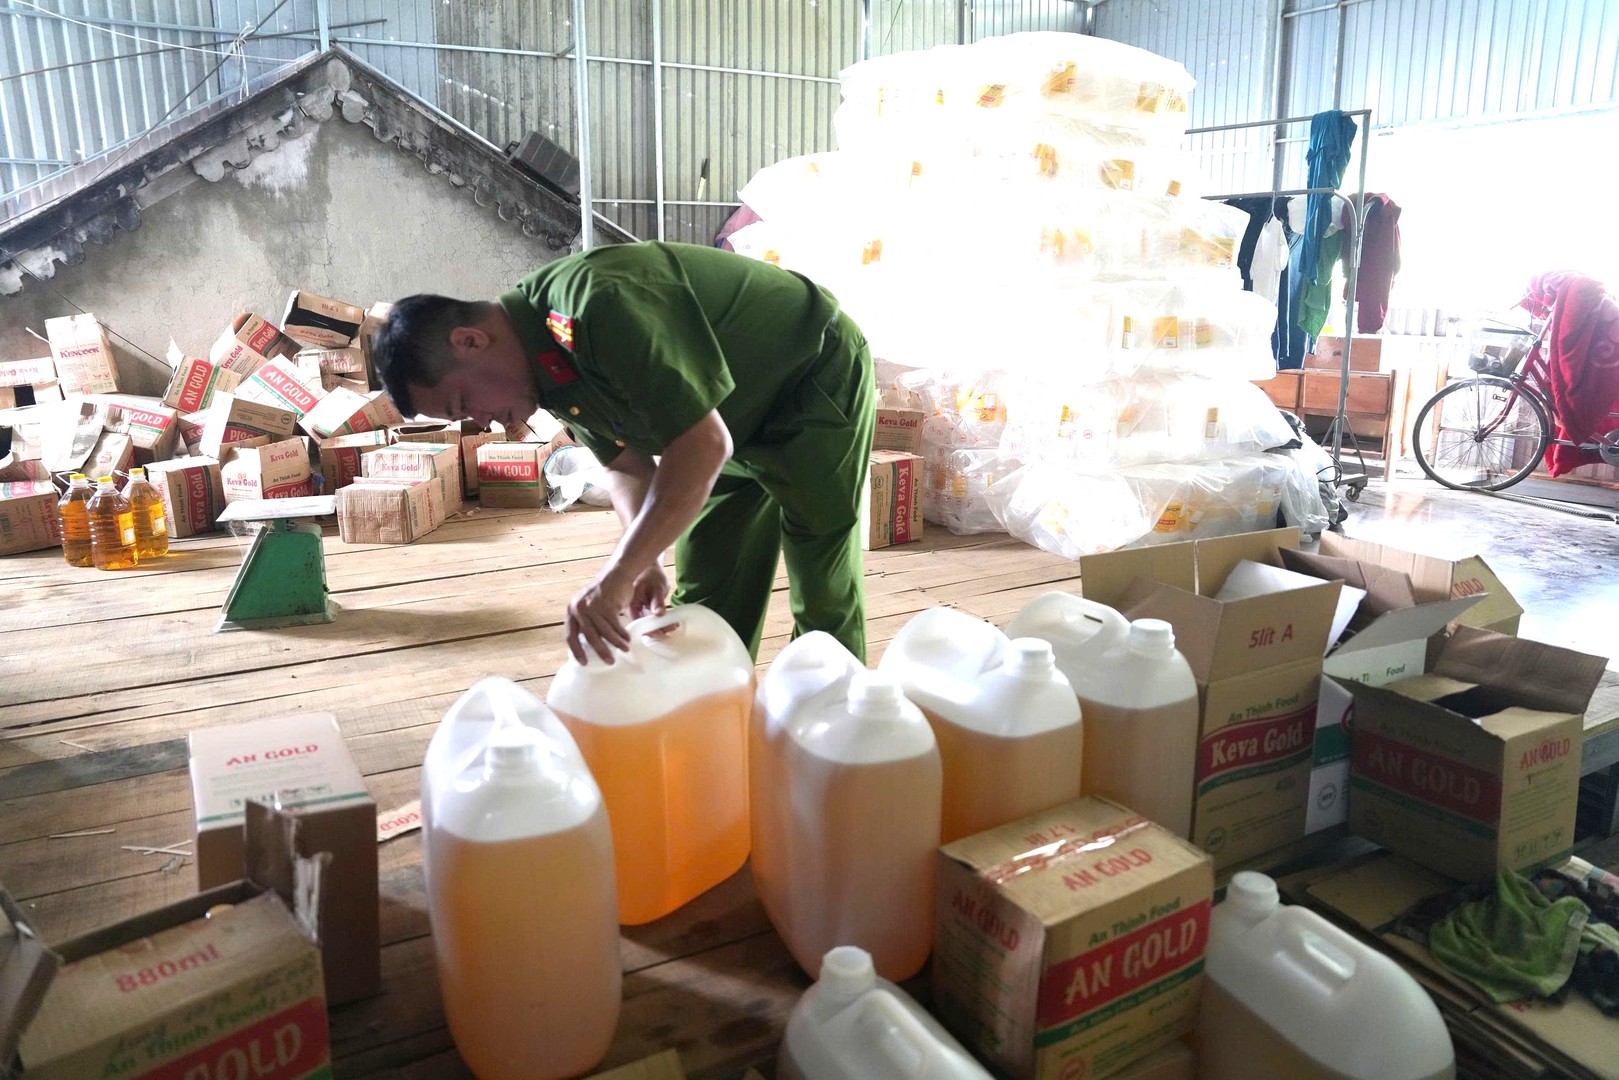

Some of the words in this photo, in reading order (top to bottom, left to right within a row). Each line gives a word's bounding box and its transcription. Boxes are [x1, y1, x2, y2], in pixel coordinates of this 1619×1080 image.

[230, 345, 243, 360] Gold
[184, 390, 195, 406] AN
[191, 364, 207, 390] GOLD
[265, 370, 285, 386] AN
[282, 382, 311, 406] GOLD
[132, 411, 163, 425] GOLD
[879, 416, 898, 426] Keva
[900, 416, 918, 427] Gold
[270, 454, 285, 462] Keva
[285, 449, 299, 459] Gold
[382, 463, 400, 472] Keva
[401, 463, 418, 472] Gold
[192, 472, 204, 498] Gold
[227, 478, 242, 486] Keva
[243, 478, 257, 487] Gold
[486, 465, 501, 477] AN
[504, 465, 532, 477] GOLD
[898, 466, 908, 502] Keva
[290, 485, 308, 497] Gold
[195, 499, 208, 530] Keva
[895, 504, 906, 535] Gold
[1281, 624, 1293, 642] A
[1386, 664, 1405, 676] Food
[1229, 711, 1242, 723] An
[1275, 693, 1299, 709] Food
[226, 754, 257, 767] AN
[265, 744, 320, 760] GOLD
[1211, 740, 1258, 768] Keva
[1264, 722, 1303, 752] Gold
[1520, 748, 1538, 769] AN
[1368, 743, 1400, 773] AN
[1411, 760, 1481, 804] GOLD
[1061, 871, 1099, 892] AN
[1094, 848, 1153, 878] GOLD
[953, 891, 977, 924] AN
[977, 909, 1020, 951] GOLD
[1088, 931, 1108, 947] An
[1150, 896, 1181, 919] Food
[116, 944, 219, 994] 880ml
[1065, 956, 1113, 1006] AN
[1123, 918, 1197, 979] GOLD
